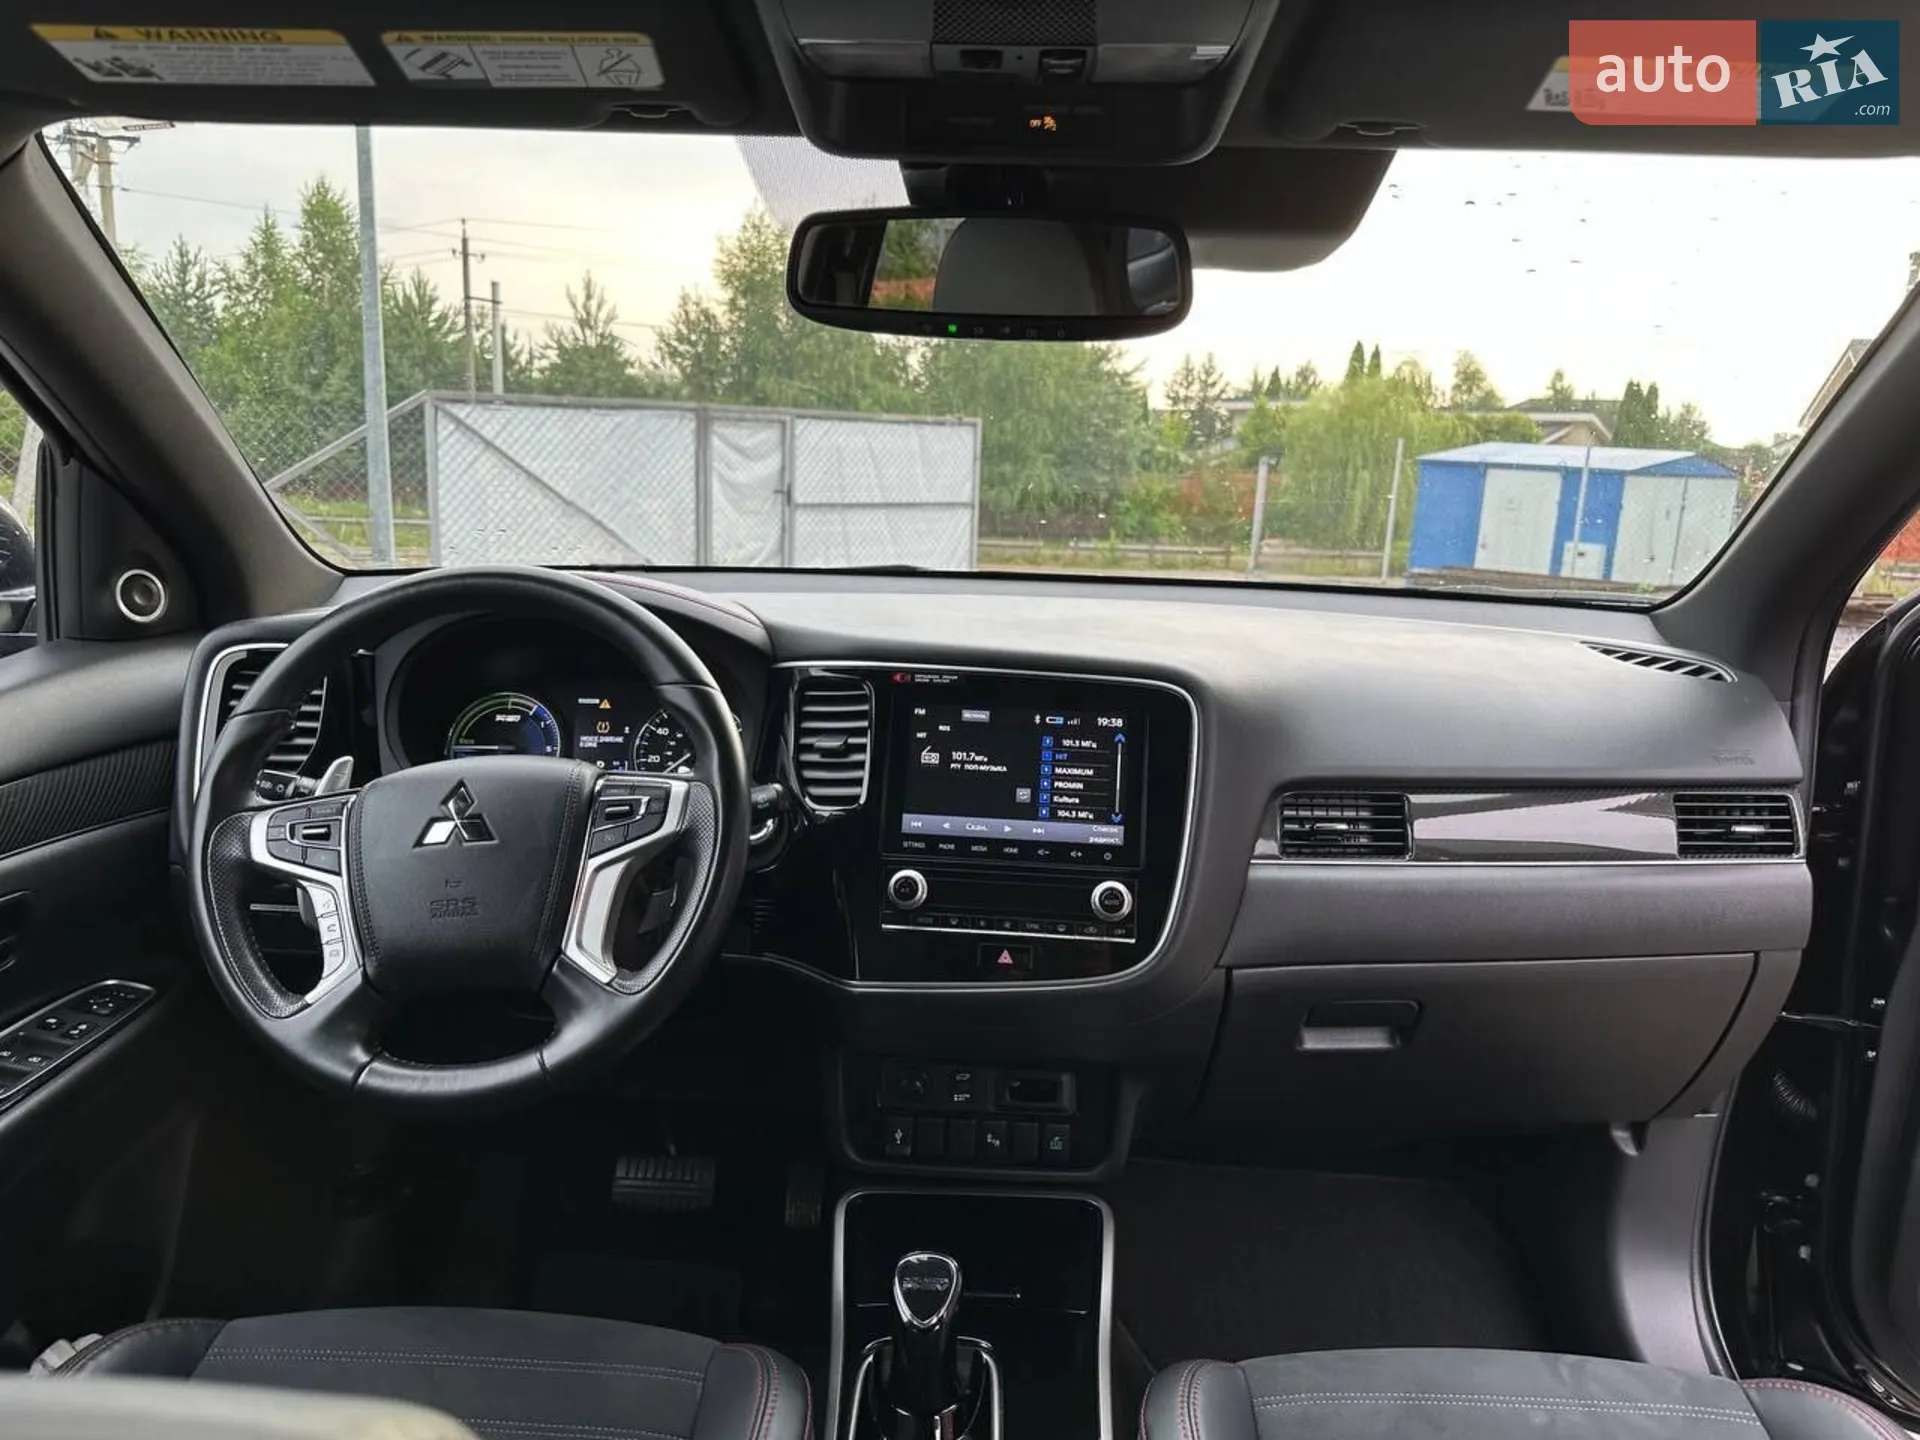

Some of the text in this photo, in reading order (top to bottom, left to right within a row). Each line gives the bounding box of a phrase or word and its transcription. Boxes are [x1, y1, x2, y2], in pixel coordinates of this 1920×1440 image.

[134, 27, 283, 43] WARNING
[1097, 717, 1123, 728] 19:38
[656, 727, 669, 735] 40
[647, 754, 660, 762] 20
[1055, 767, 1093, 775] MAXIMUM
